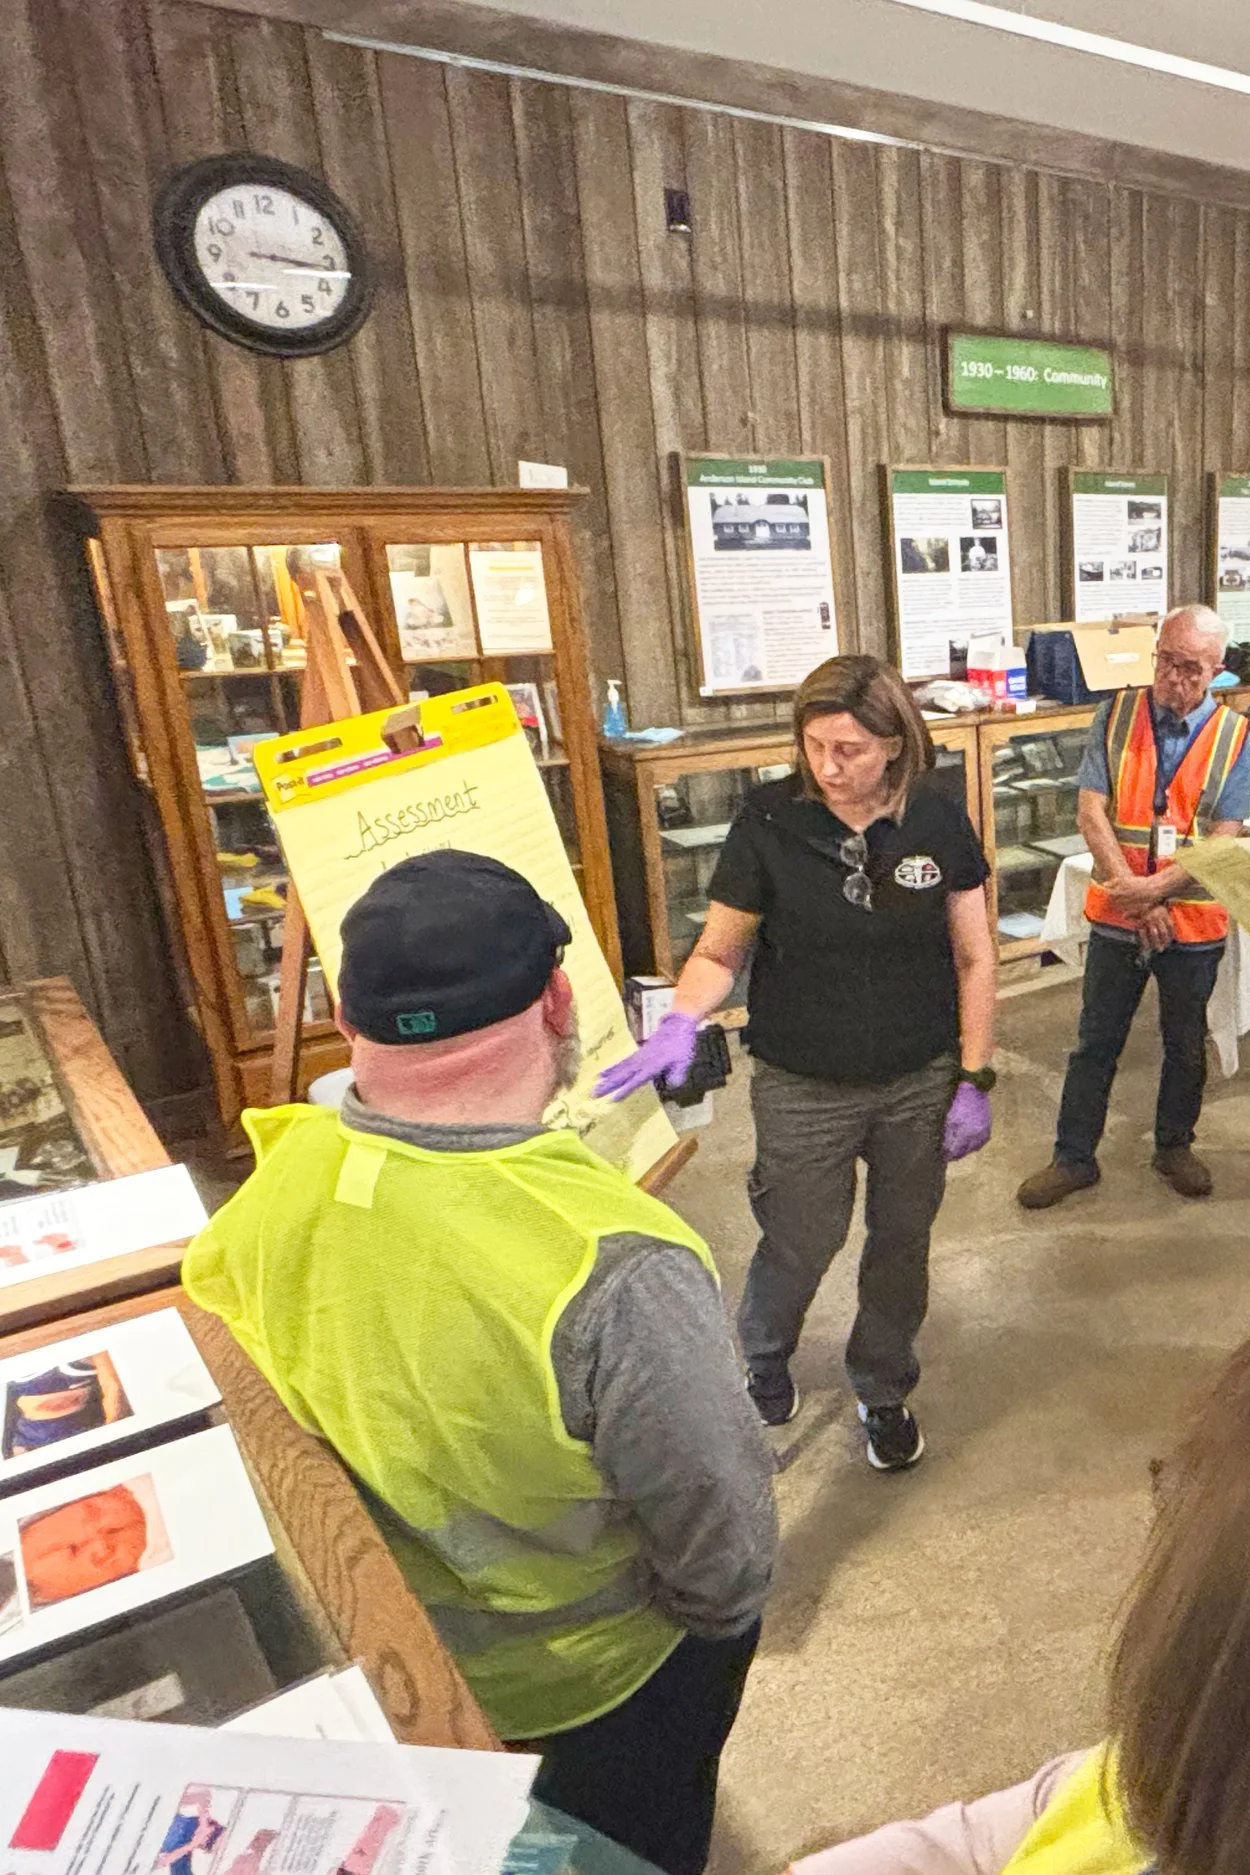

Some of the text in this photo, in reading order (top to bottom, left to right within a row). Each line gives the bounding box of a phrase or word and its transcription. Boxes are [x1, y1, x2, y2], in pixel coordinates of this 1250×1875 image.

[232, 200, 245, 218] 11
[254, 195, 275, 215] 12
[208, 217, 235, 236] 10
[311, 227, 323, 245] 2
[206, 244, 222, 263] 9
[318, 278, 332, 295] 4
[246, 291, 259, 310] 7
[301, 295, 315, 313] 5
[275, 301, 290, 319] 6
[1043, 367, 1107, 389] Community
[276, 776, 305, 791] Post-it
[357, 780, 478, 849] Assessment
